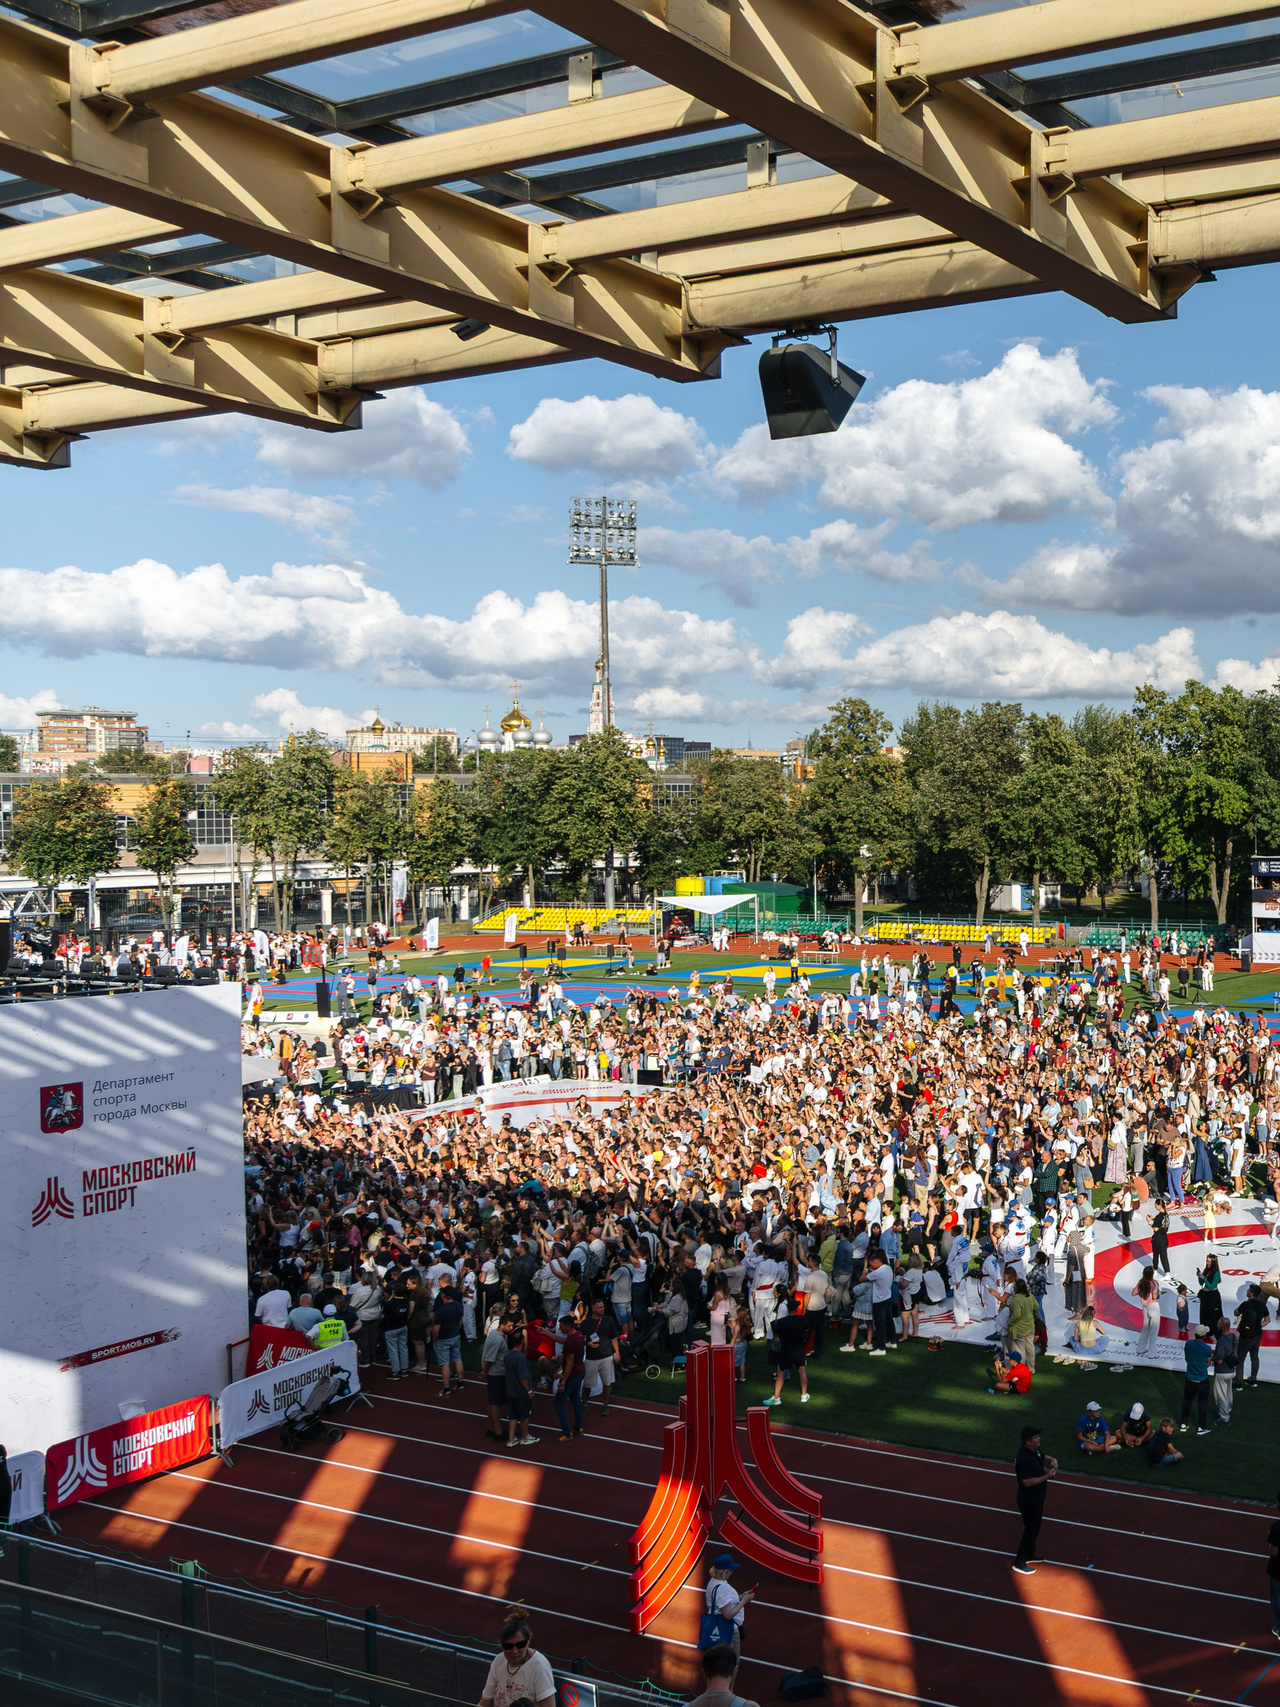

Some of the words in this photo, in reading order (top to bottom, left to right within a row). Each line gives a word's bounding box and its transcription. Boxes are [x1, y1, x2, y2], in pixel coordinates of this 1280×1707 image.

[93, 1072, 175, 1094] Департамент
[93, 1092, 136, 1107] спорта
[93, 1107, 137, 1123] города
[141, 1100, 187, 1115] Москвы
[82, 1146, 196, 1193] МОСКОВСКИЙ
[83, 1185, 137, 1217] СПОРТ
[91, 1336, 156, 1360] SPORT.MOS.RU
[273, 1388, 303, 1412] СПОРТ
[112, 1411, 196, 1458] МОСКОВСКИЙ
[113, 1447, 154, 1477] СПОРТ
